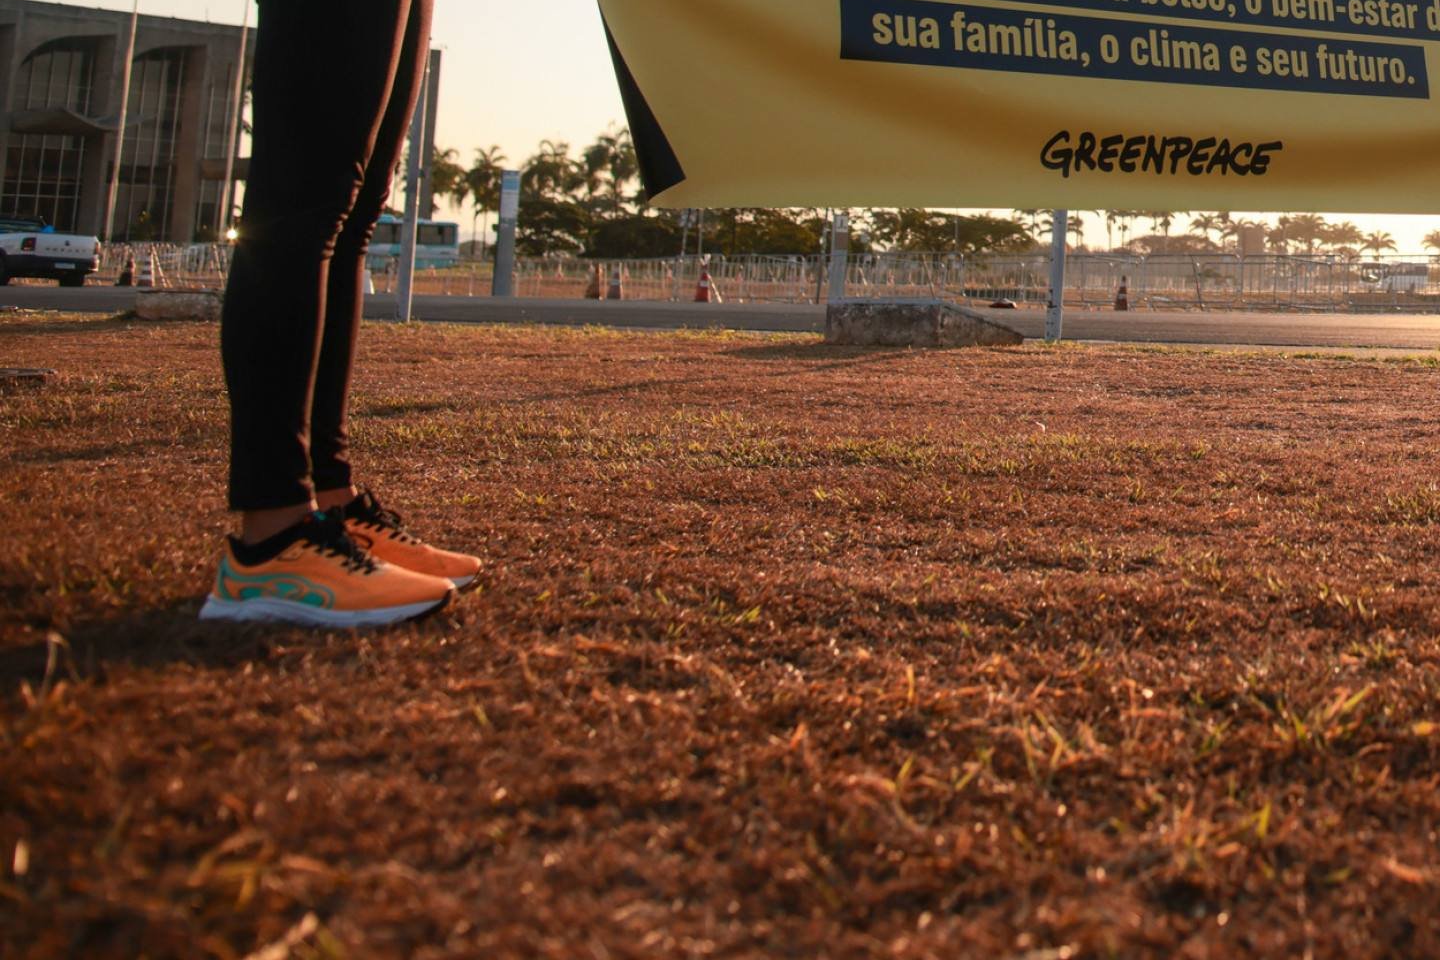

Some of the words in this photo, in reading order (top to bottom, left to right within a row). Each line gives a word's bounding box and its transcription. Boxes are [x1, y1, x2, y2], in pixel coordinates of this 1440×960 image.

[872, 12, 940, 49] sua
[950, 10, 1091, 68] família,
[1099, 34, 1120, 64] o
[1130, 29, 1221, 72] clima
[1229, 45, 1248, 74] e
[1256, 47, 1309, 78] seu
[1315, 43, 1416, 85] futuro.
[1039, 130, 1284, 179] GREENPEACE
